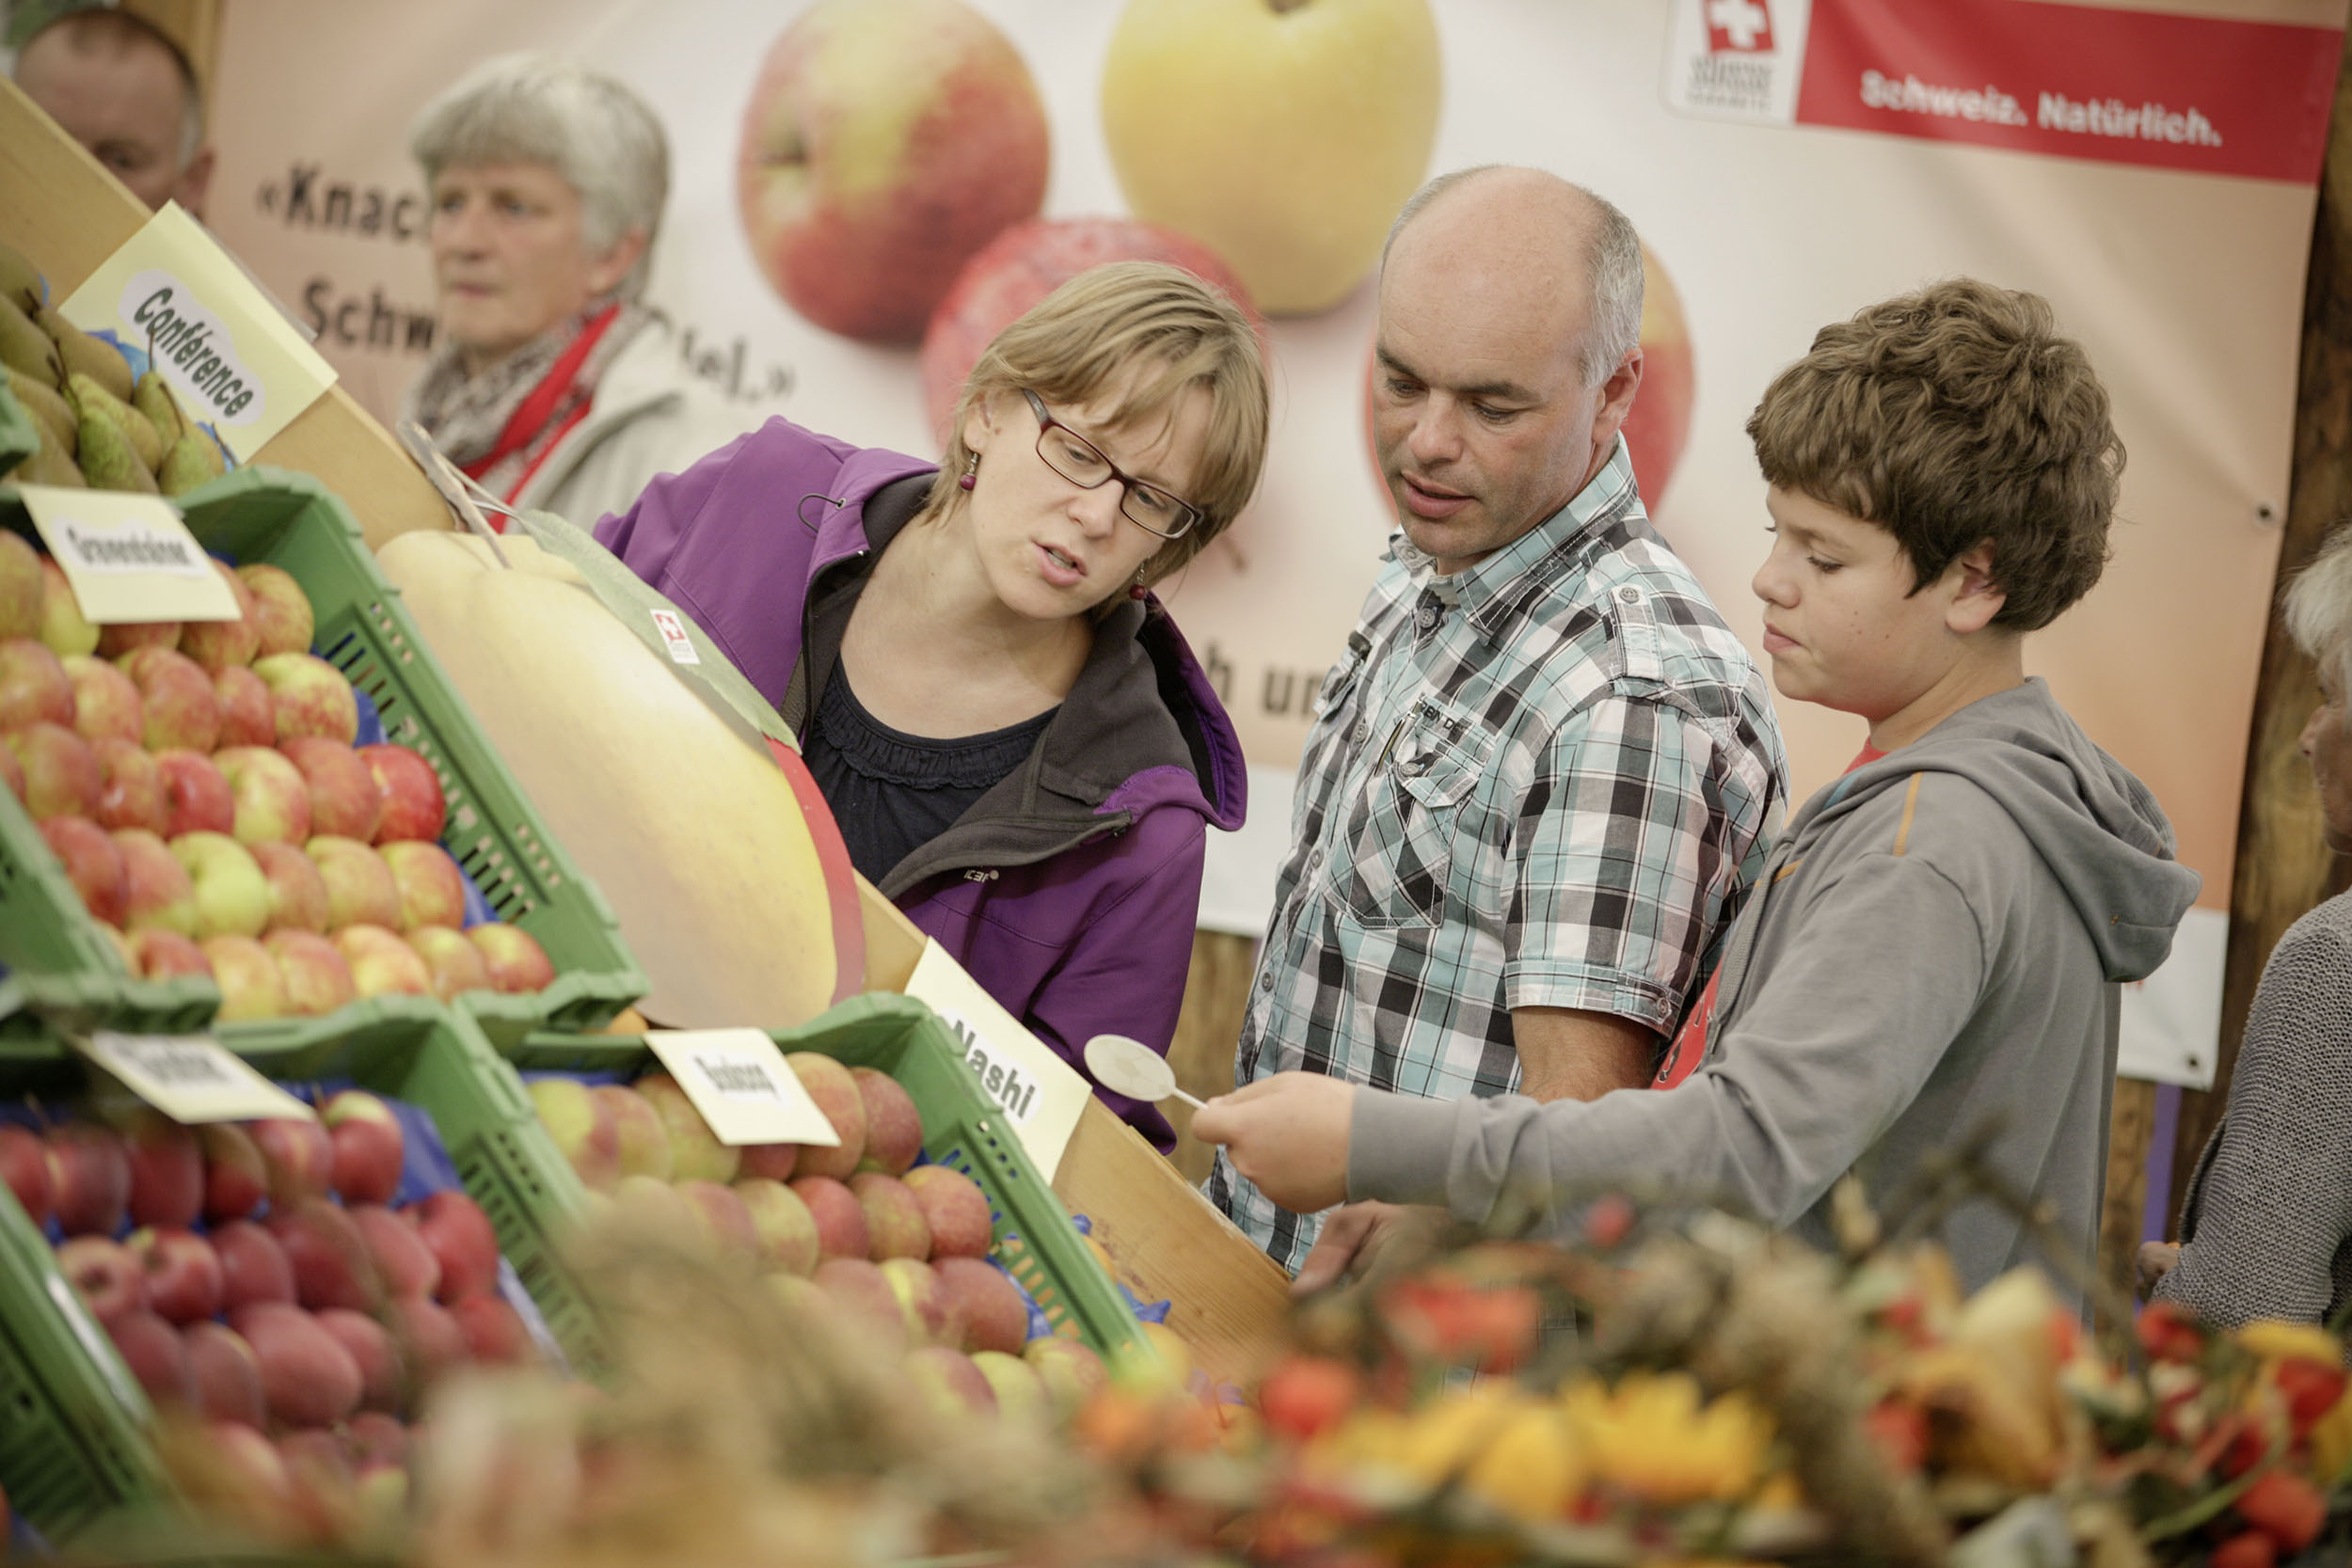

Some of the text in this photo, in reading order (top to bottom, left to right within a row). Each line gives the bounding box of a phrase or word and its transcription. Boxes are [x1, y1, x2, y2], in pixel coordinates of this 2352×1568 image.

[1860, 69, 2223, 147] Schweiz. Natürlich.
[255, 163, 425, 242] «Knac
[134, 287, 254, 419] Conférence
[301, 277, 437, 351] Schw
